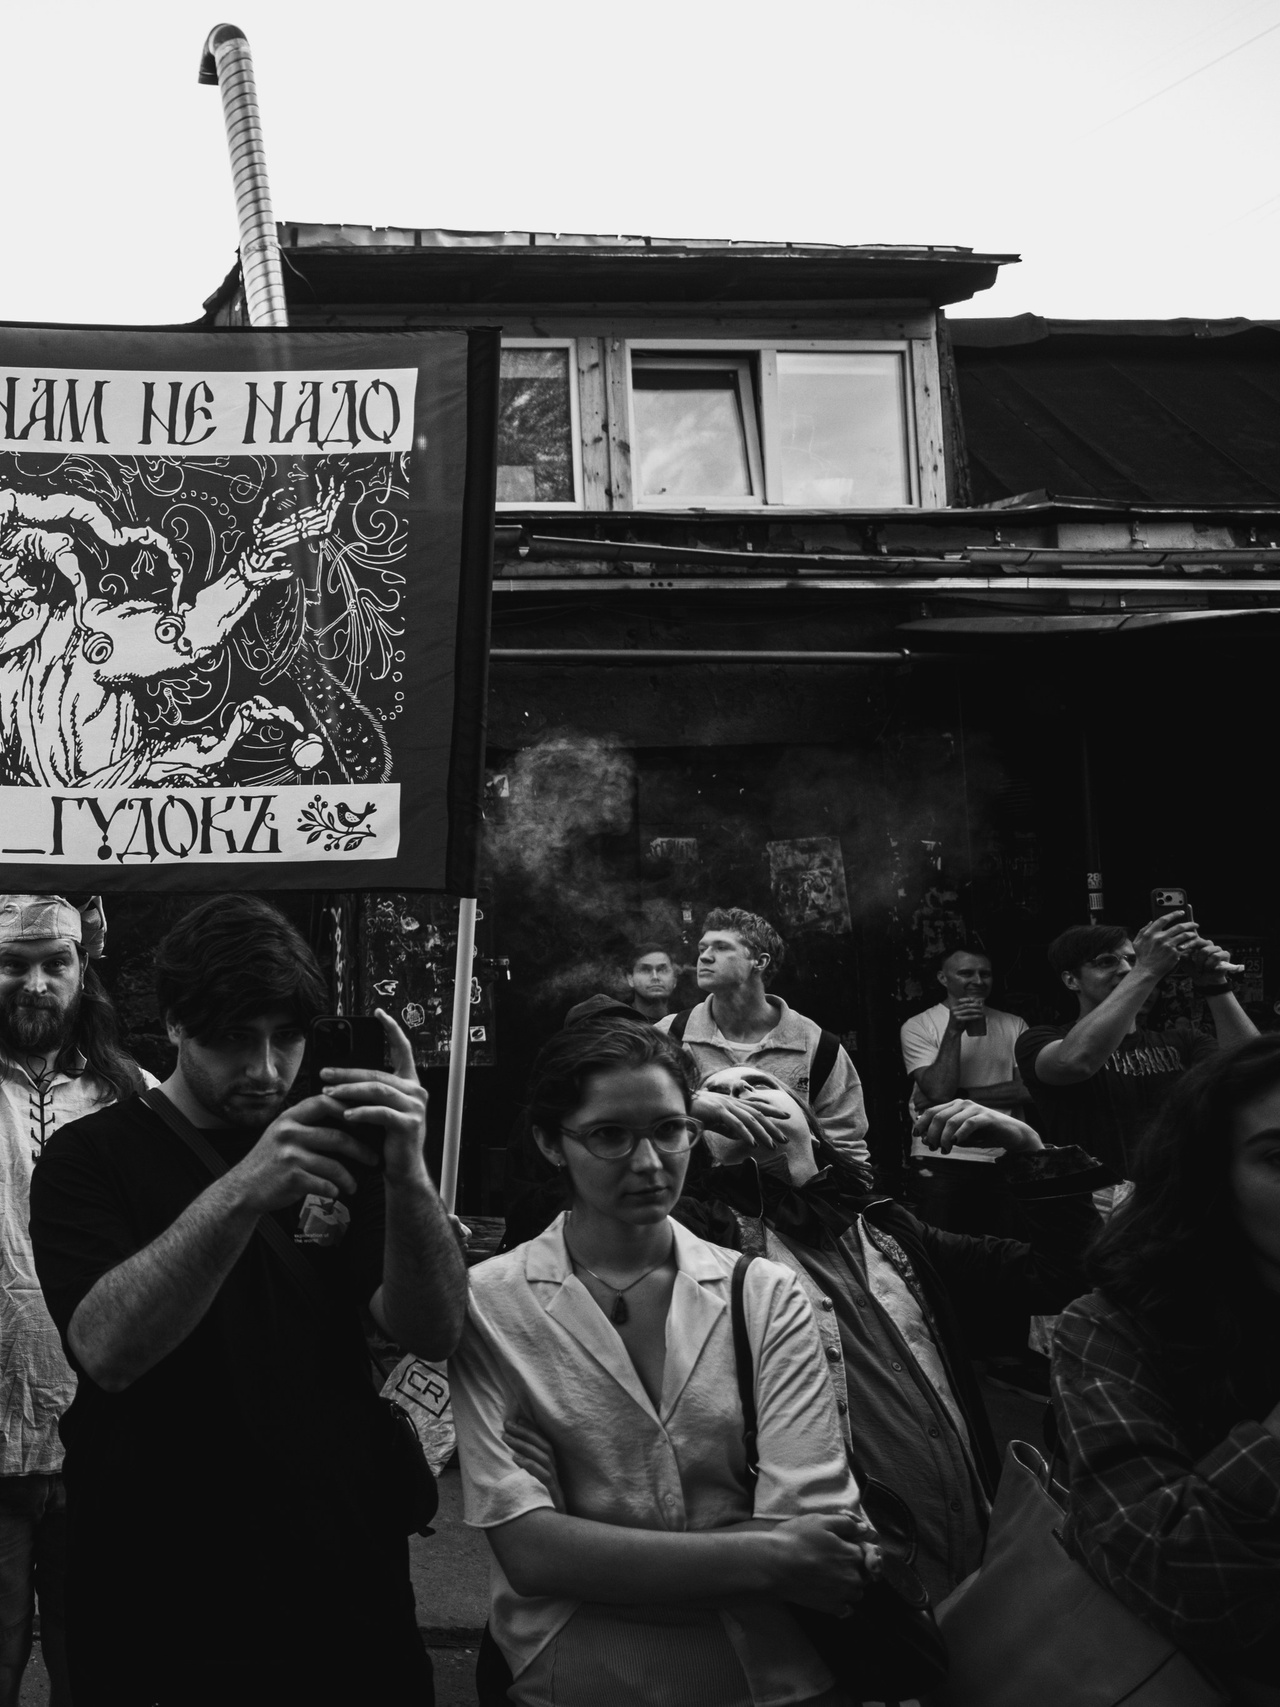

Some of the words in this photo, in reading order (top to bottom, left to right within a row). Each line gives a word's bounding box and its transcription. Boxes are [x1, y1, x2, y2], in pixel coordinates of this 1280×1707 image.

[137, 379, 217, 446] НЕ
[242, 378, 401, 450] НАДО
[407, 1370, 445, 1404] CR
